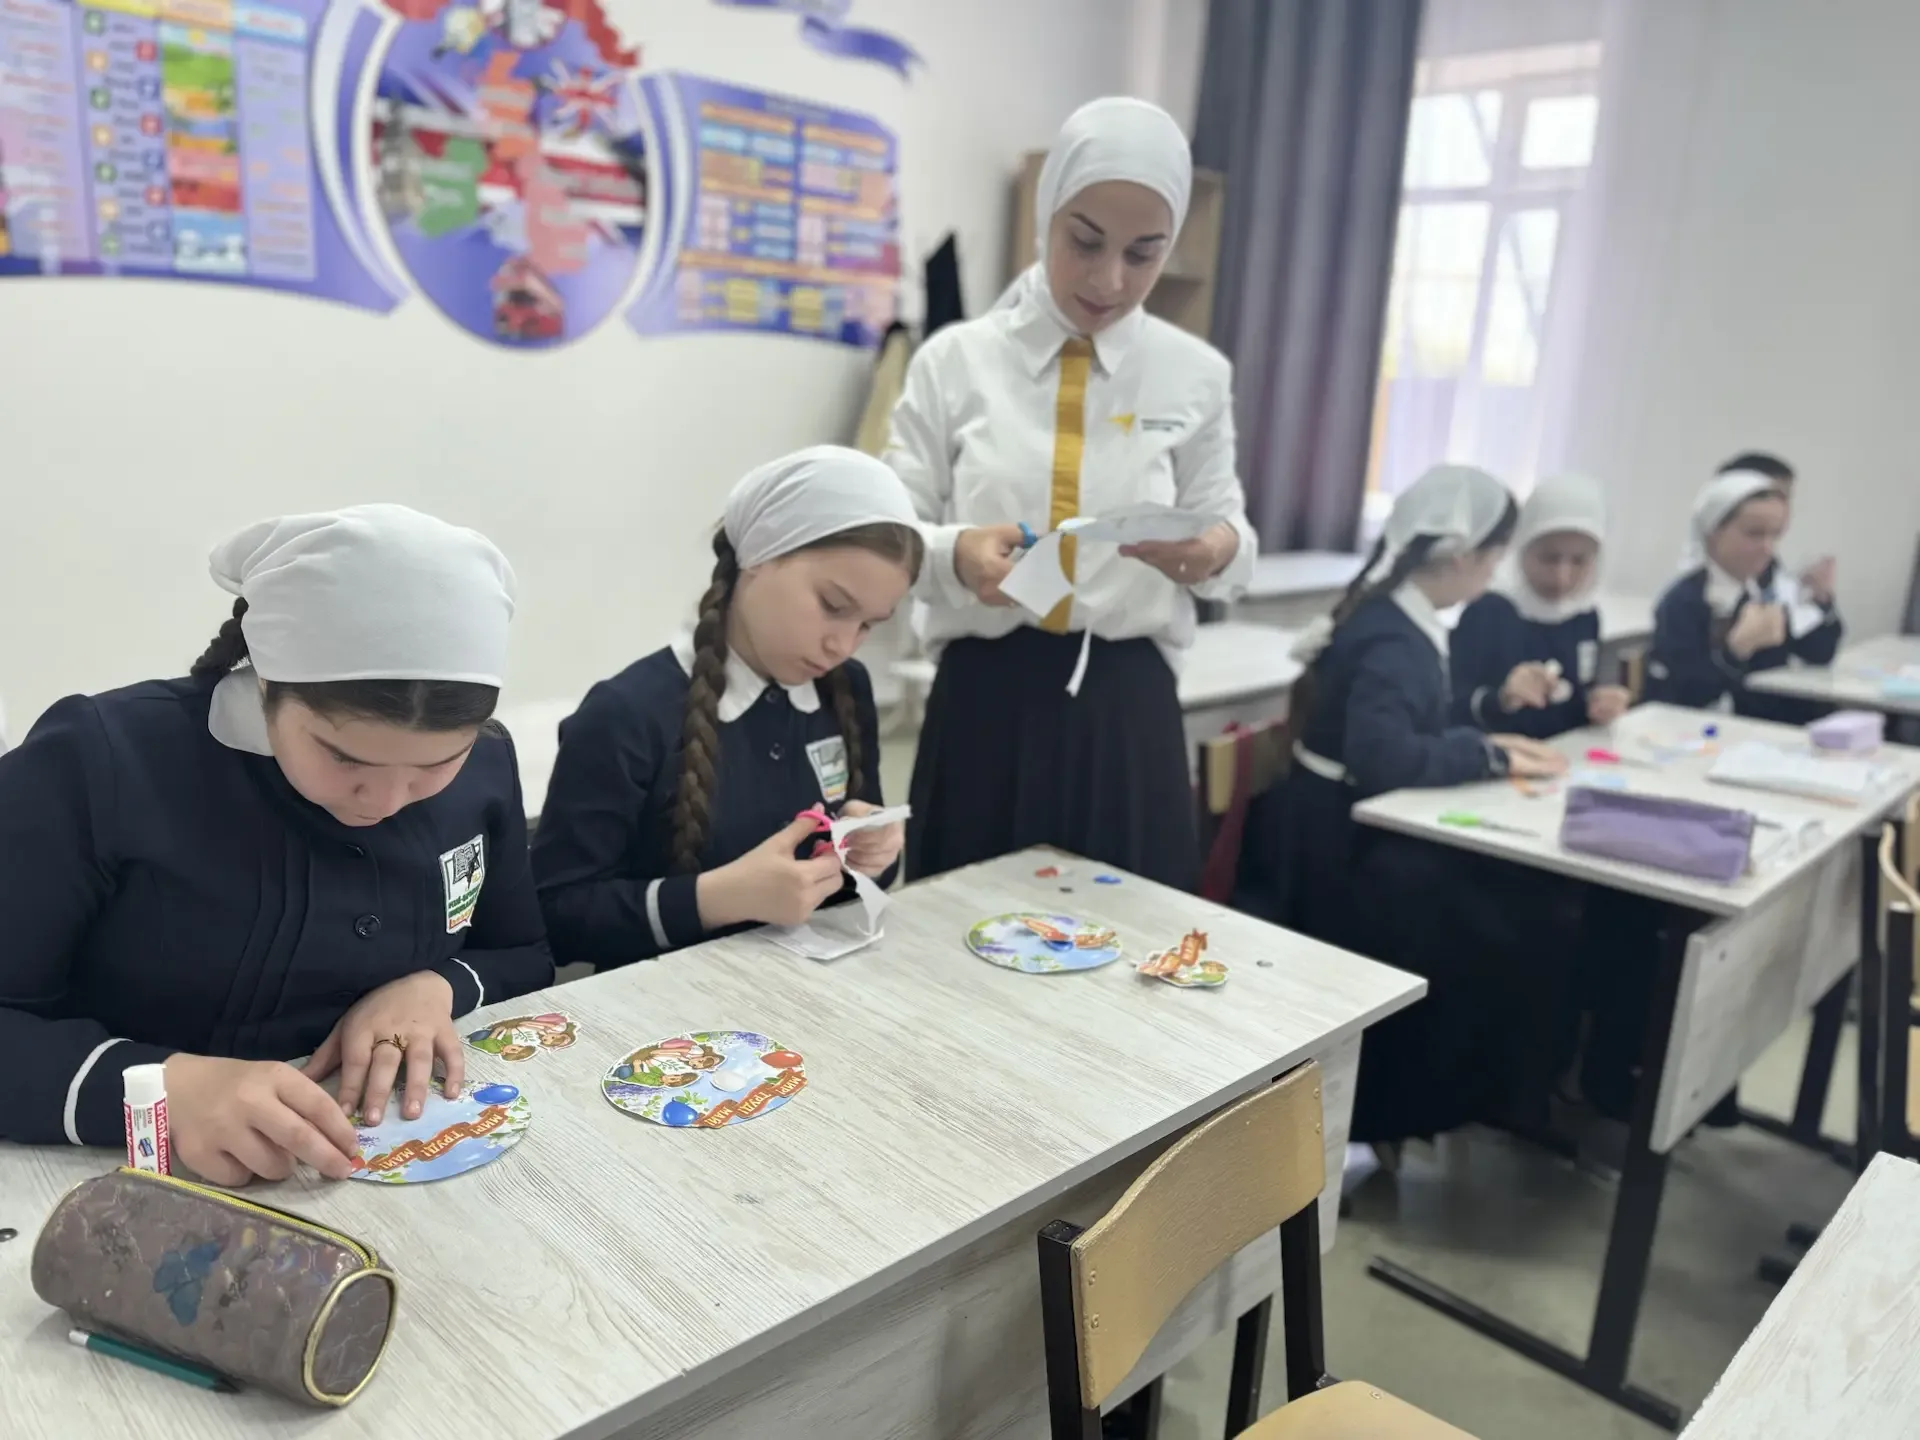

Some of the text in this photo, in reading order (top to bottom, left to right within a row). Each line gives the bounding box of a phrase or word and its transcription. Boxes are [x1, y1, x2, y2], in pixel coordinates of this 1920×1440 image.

[774, 1075, 802, 1095] МИР!
[738, 1091, 772, 1115] ТРУД!
[470, 1113, 503, 1135] МИР!
[156, 1101, 168, 1177] ErichKrause
[420, 1130, 465, 1157] ТРУД!
